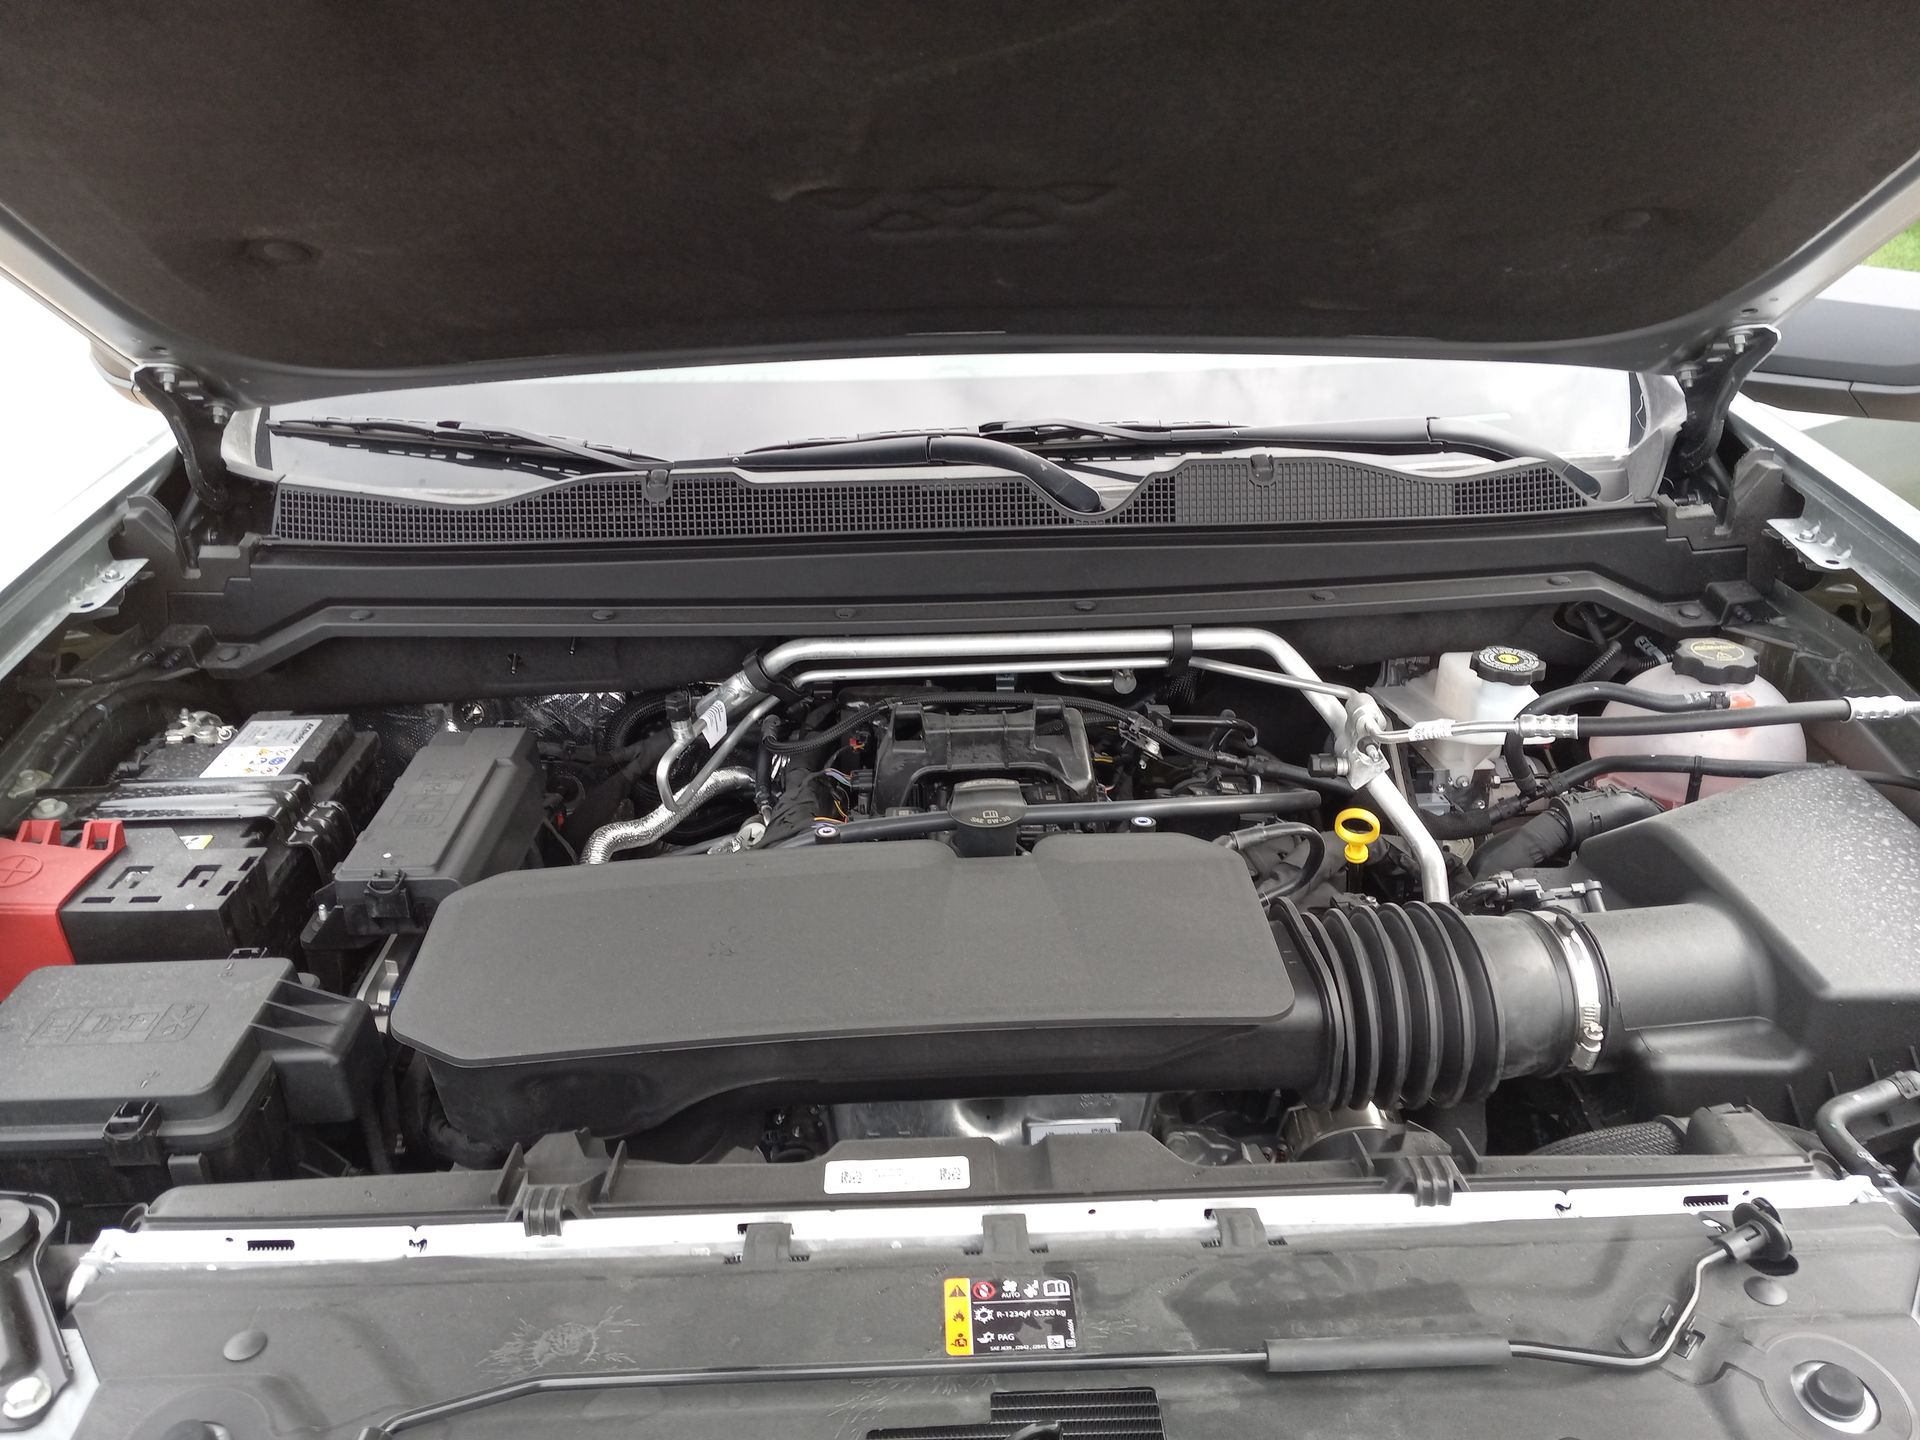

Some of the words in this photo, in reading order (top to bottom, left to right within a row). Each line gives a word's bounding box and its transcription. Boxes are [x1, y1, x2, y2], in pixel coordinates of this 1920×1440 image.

[1001, 1291, 1021, 1299] AUTO
[996, 1309, 1031, 1319] R-1234yf
[1033, 1309, 1055, 1317] 0.520
[1056, 1308, 1067, 1318] kg
[997, 1333, 1015, 1341] PAG
